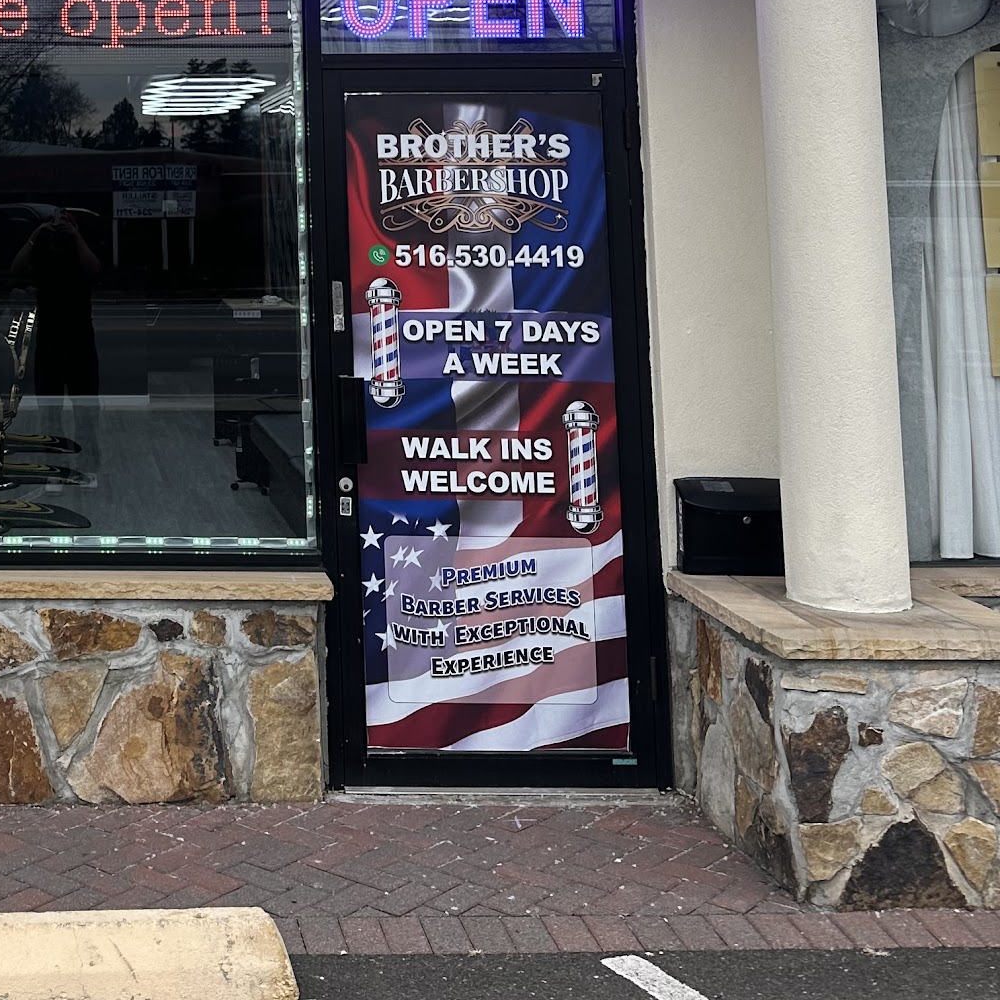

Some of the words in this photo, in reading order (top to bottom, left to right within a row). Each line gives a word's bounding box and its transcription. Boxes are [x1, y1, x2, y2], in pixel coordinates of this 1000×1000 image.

[376, 133, 571, 159] BROTHER'S
[378, 166, 570, 205] BARBERSHOP
[394, 244, 585, 268] 516.530.4419
[402, 319, 485, 344] OPEN
[494, 320, 511, 343] 7
[521, 320, 600, 343] DAYS
[442, 353, 464, 375] A
[472, 353, 562, 376] WEEK
[400, 436, 493, 461] WALK
[501, 438, 553, 462] INS
[400, 471, 556, 495] WELCOME
[441, 557, 537, 588] PREMIUM
[400, 594, 480, 618] BARBER
[484, 586, 581, 610] SERVICES
[393, 621, 446, 647] WITH
[454, 616, 590, 644] EXCEPTIONAL
[430, 645, 555, 678] EXPERIENCE
